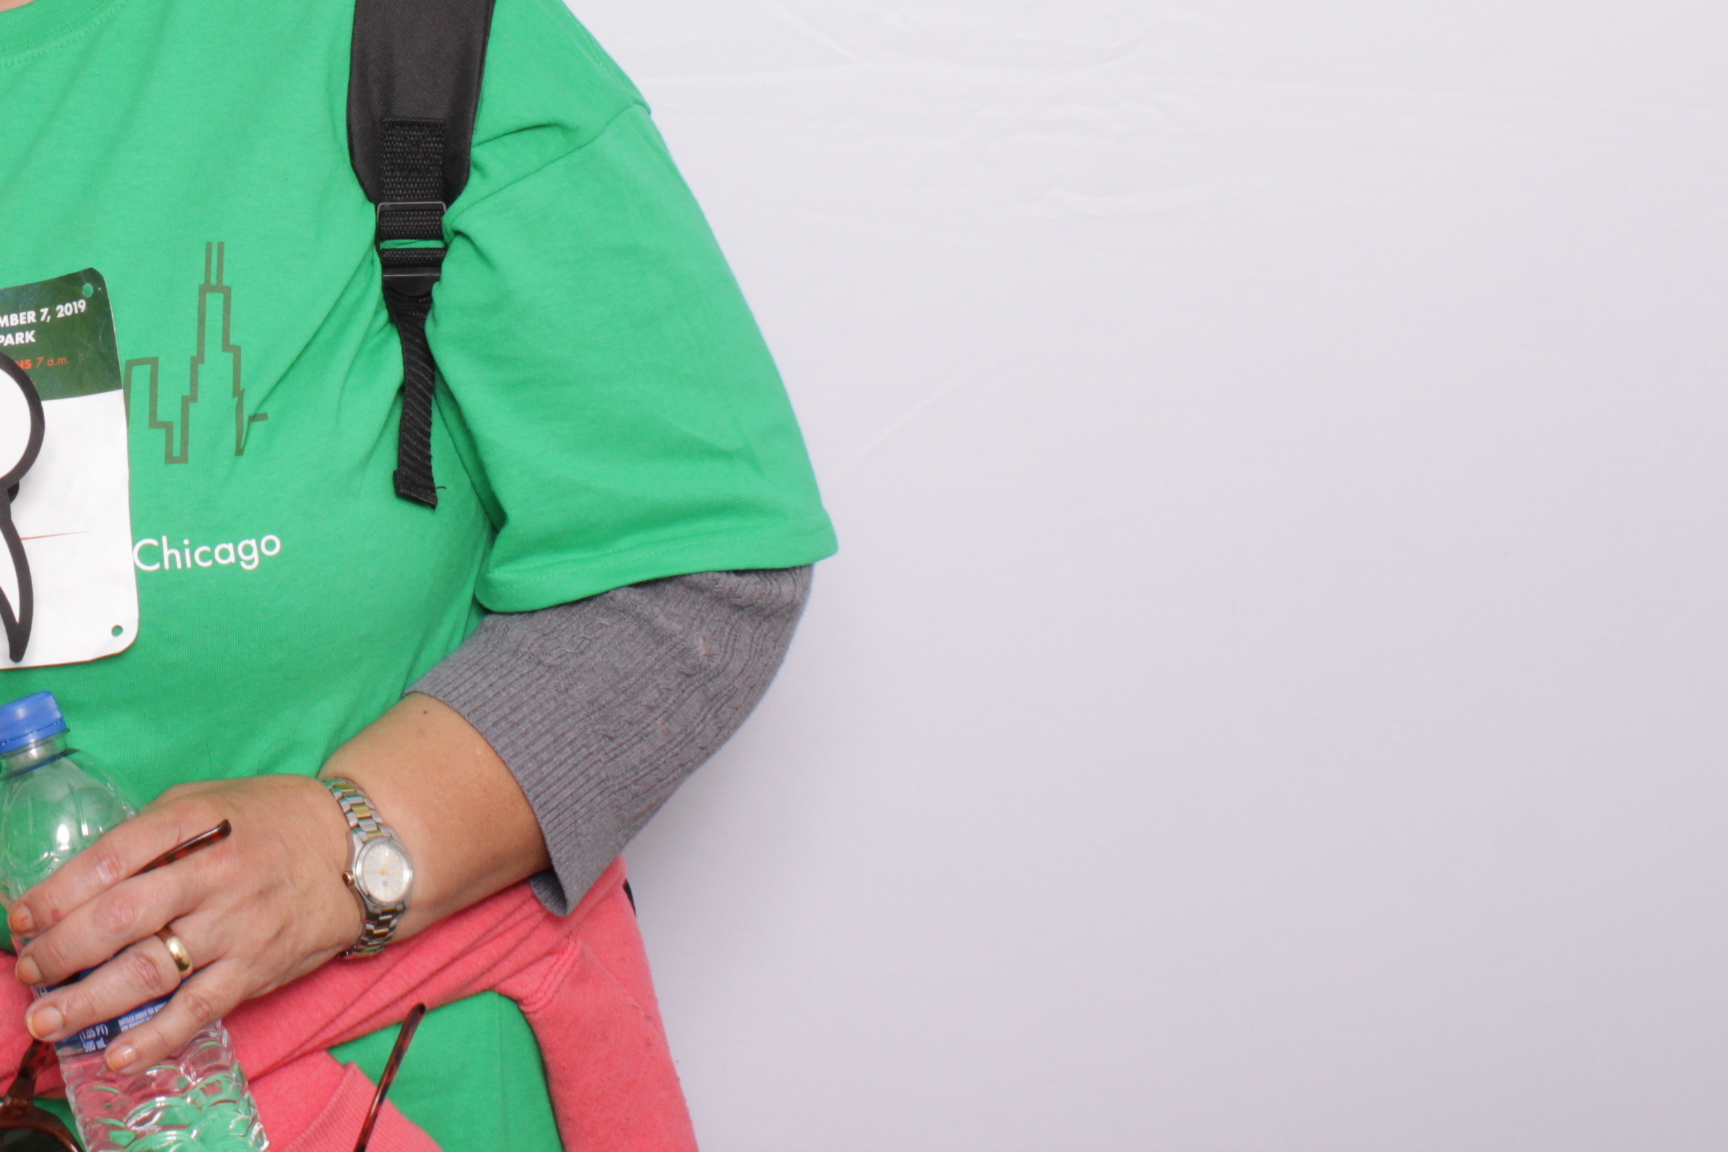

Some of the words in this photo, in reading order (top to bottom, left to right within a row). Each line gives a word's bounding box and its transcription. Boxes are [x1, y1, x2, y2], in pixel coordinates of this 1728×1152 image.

[39, 307, 52, 323] 7,
[55, 299, 87, 319] 2019
[35, 356, 45, 368] 7
[46, 356, 70, 367] a.m.
[132, 534, 282, 571] Chicago
[95, 1024, 109, 1036] PT)
